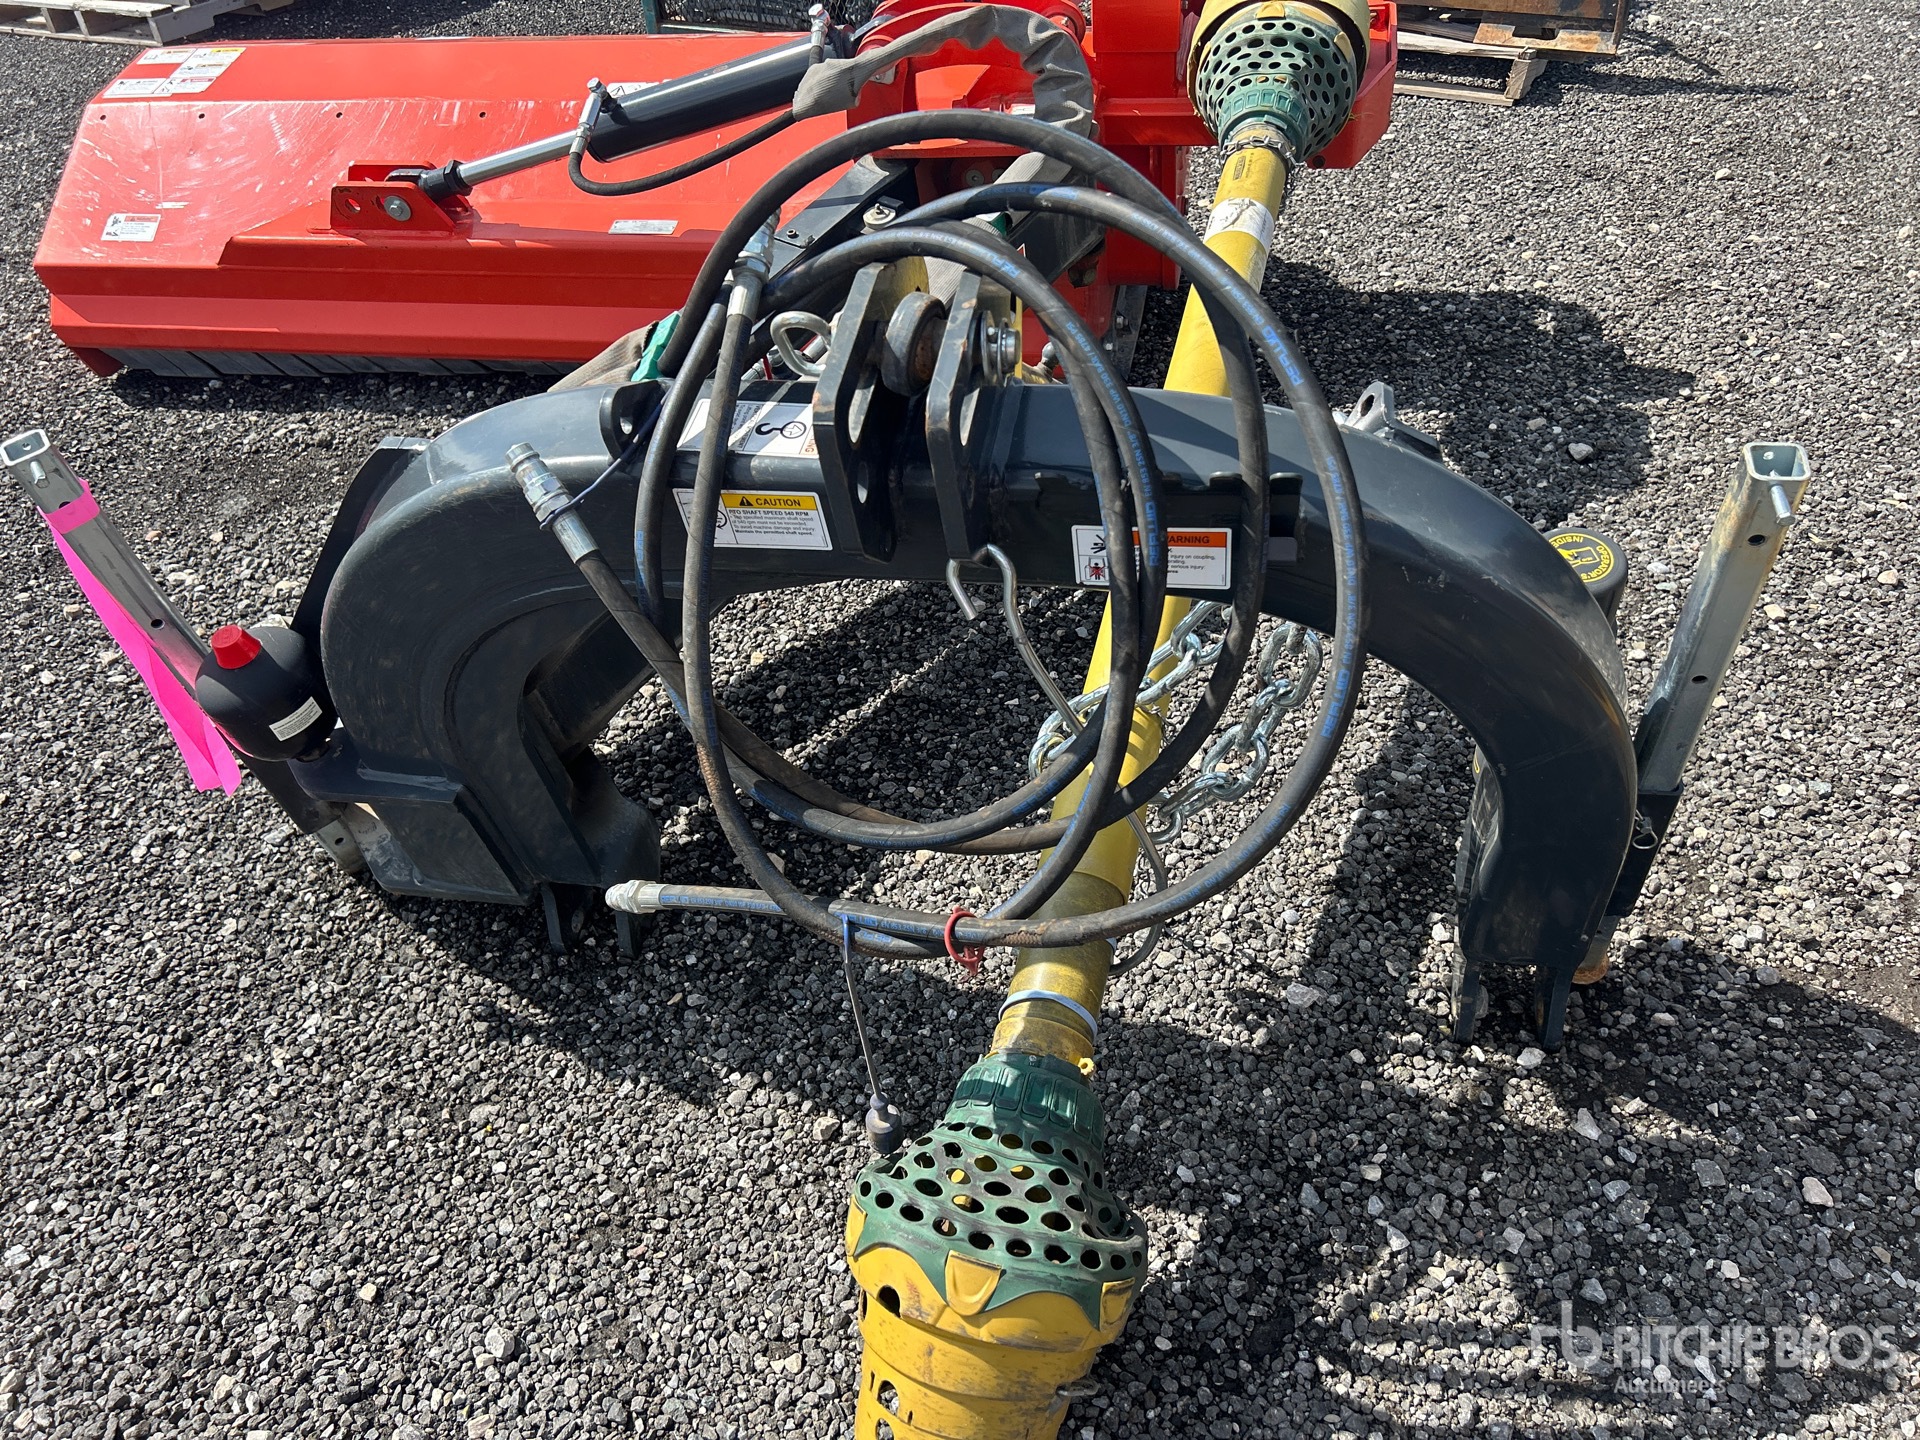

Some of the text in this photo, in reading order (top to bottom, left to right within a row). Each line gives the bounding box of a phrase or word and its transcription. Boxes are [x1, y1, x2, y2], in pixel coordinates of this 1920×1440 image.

[1066, 321, 1079, 335] PSI
[1075, 333, 1091, 351] 4785
[1091, 355, 1105, 373] BAR
[1100, 372, 1113, 388] 330
[1109, 389, 1121, 402] WP
[1116, 403, 1132, 427] DN10
[1134, 449, 1146, 467] 2SN
[1140, 467, 1150, 484] 853
[1143, 484, 1152, 497] EN
[755, 497, 801, 507] CAUTION
[1167, 535, 1210, 544] ARNING
[1550, 535, 1584, 548] INSIDE
[1580, 545, 1610, 580] OPERATOR'S
